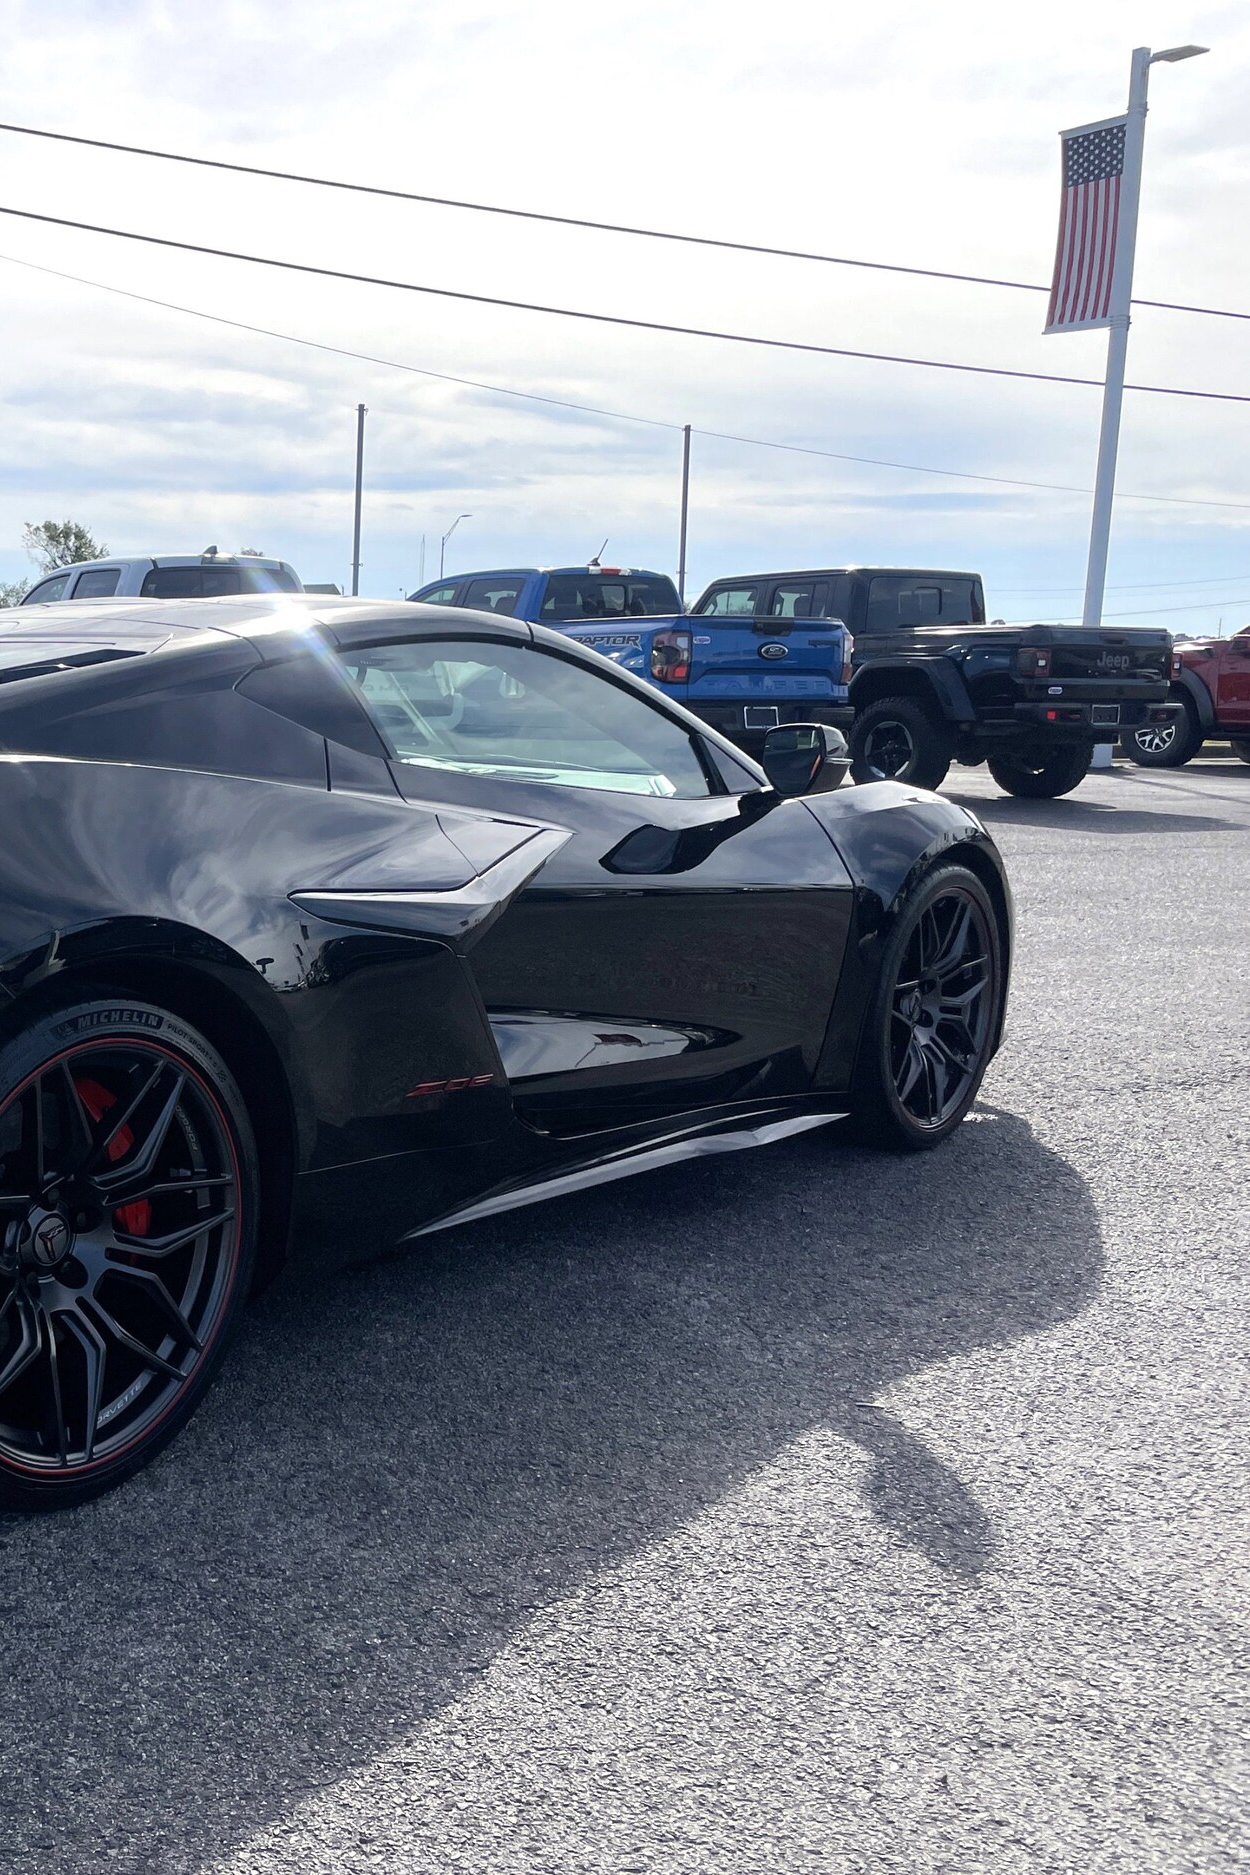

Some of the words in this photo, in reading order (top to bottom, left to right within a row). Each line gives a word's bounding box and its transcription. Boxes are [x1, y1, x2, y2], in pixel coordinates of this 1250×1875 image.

[1097, 651, 1130, 670] Jeep
[77, 1010, 159, 1030] MICHELIN
[167, 1023, 188, 1040] PILOT
[188, 1036, 210, 1061] SPORT
[96, 1381, 142, 1424] ORVETTE
